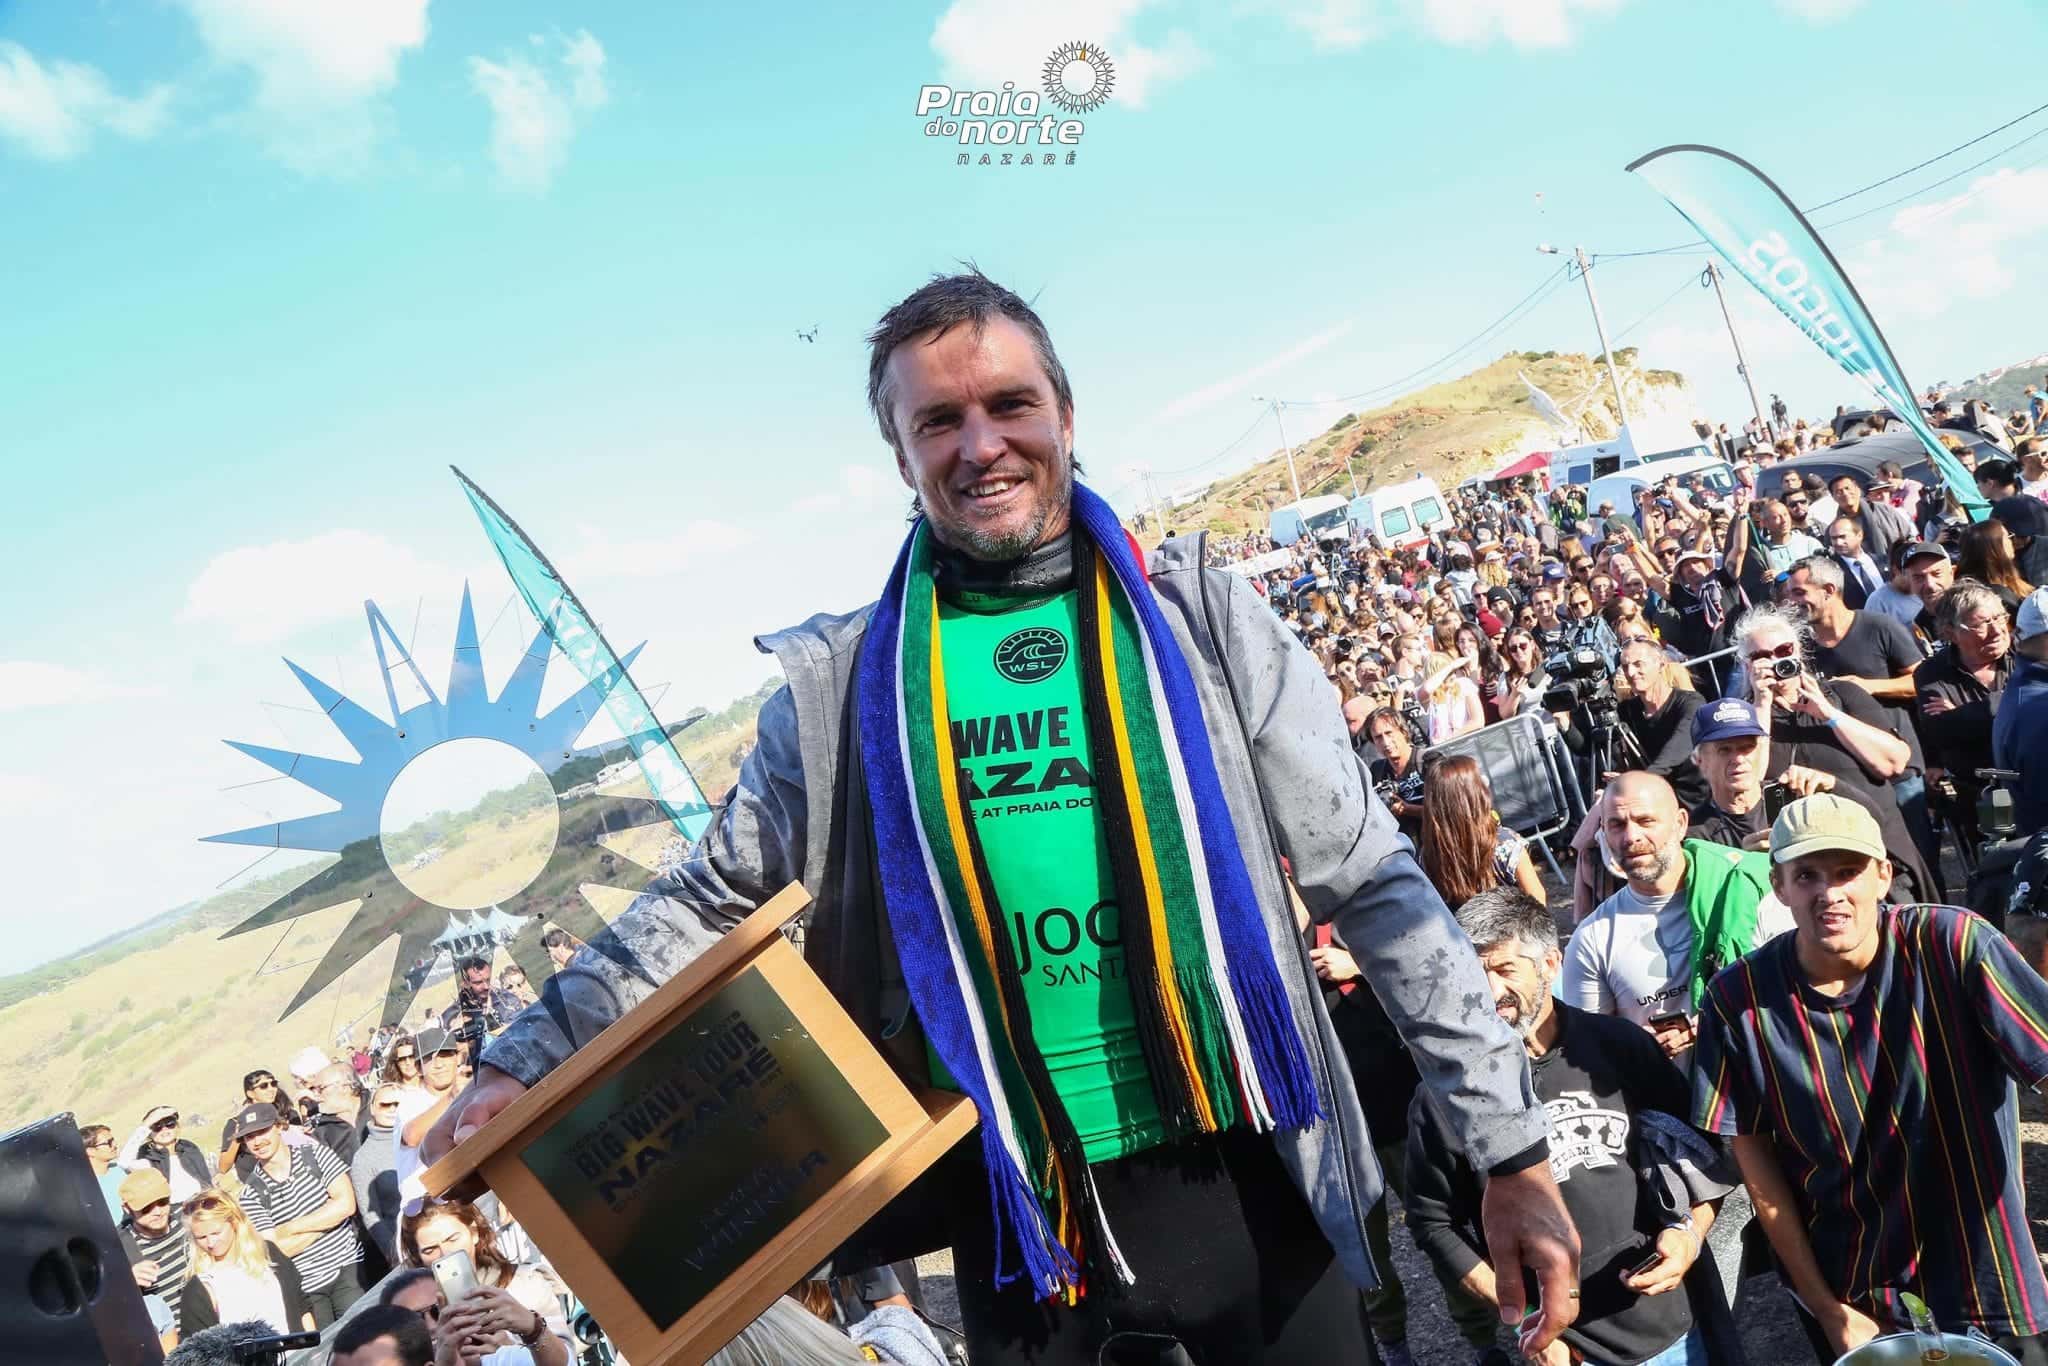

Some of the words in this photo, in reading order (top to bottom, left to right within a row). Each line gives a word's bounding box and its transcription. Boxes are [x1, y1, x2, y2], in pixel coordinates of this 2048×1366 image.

[1009, 661, 1053, 673] WSL
[952, 706, 1070, 757] WAVE
[981, 807, 1003, 819] AT
[1007, 801, 1061, 816] PRAIA
[1066, 798, 1094, 809] DO
[1042, 956, 1128, 987] SANT
[1637, 985, 1689, 1006] UNDER
